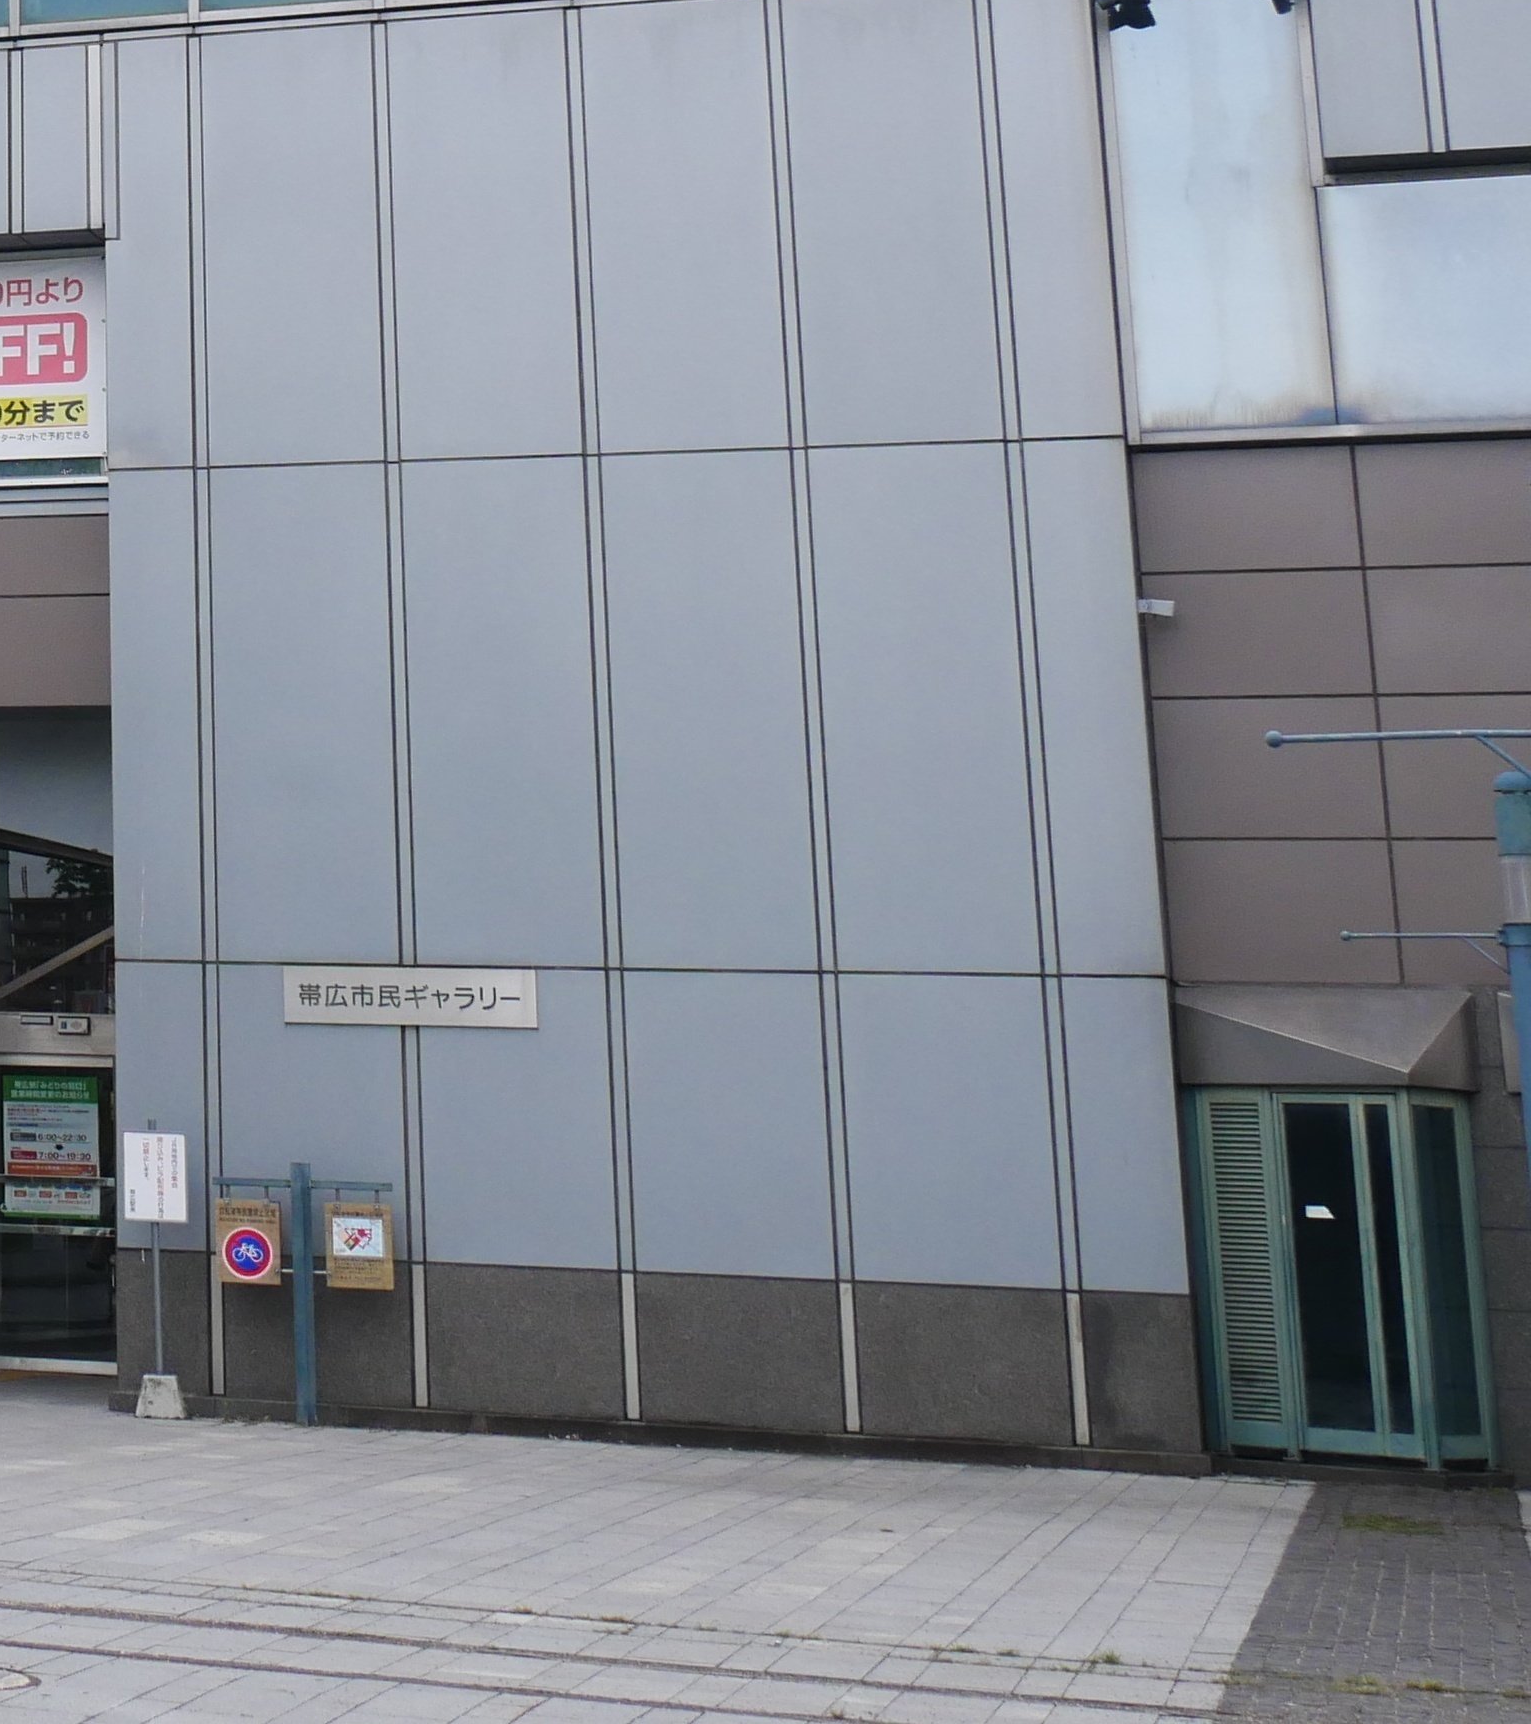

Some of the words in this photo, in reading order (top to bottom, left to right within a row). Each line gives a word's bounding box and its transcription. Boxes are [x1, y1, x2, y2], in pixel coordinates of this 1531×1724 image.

[298, 982, 521, 1011] 帯広市民ギャラリー
